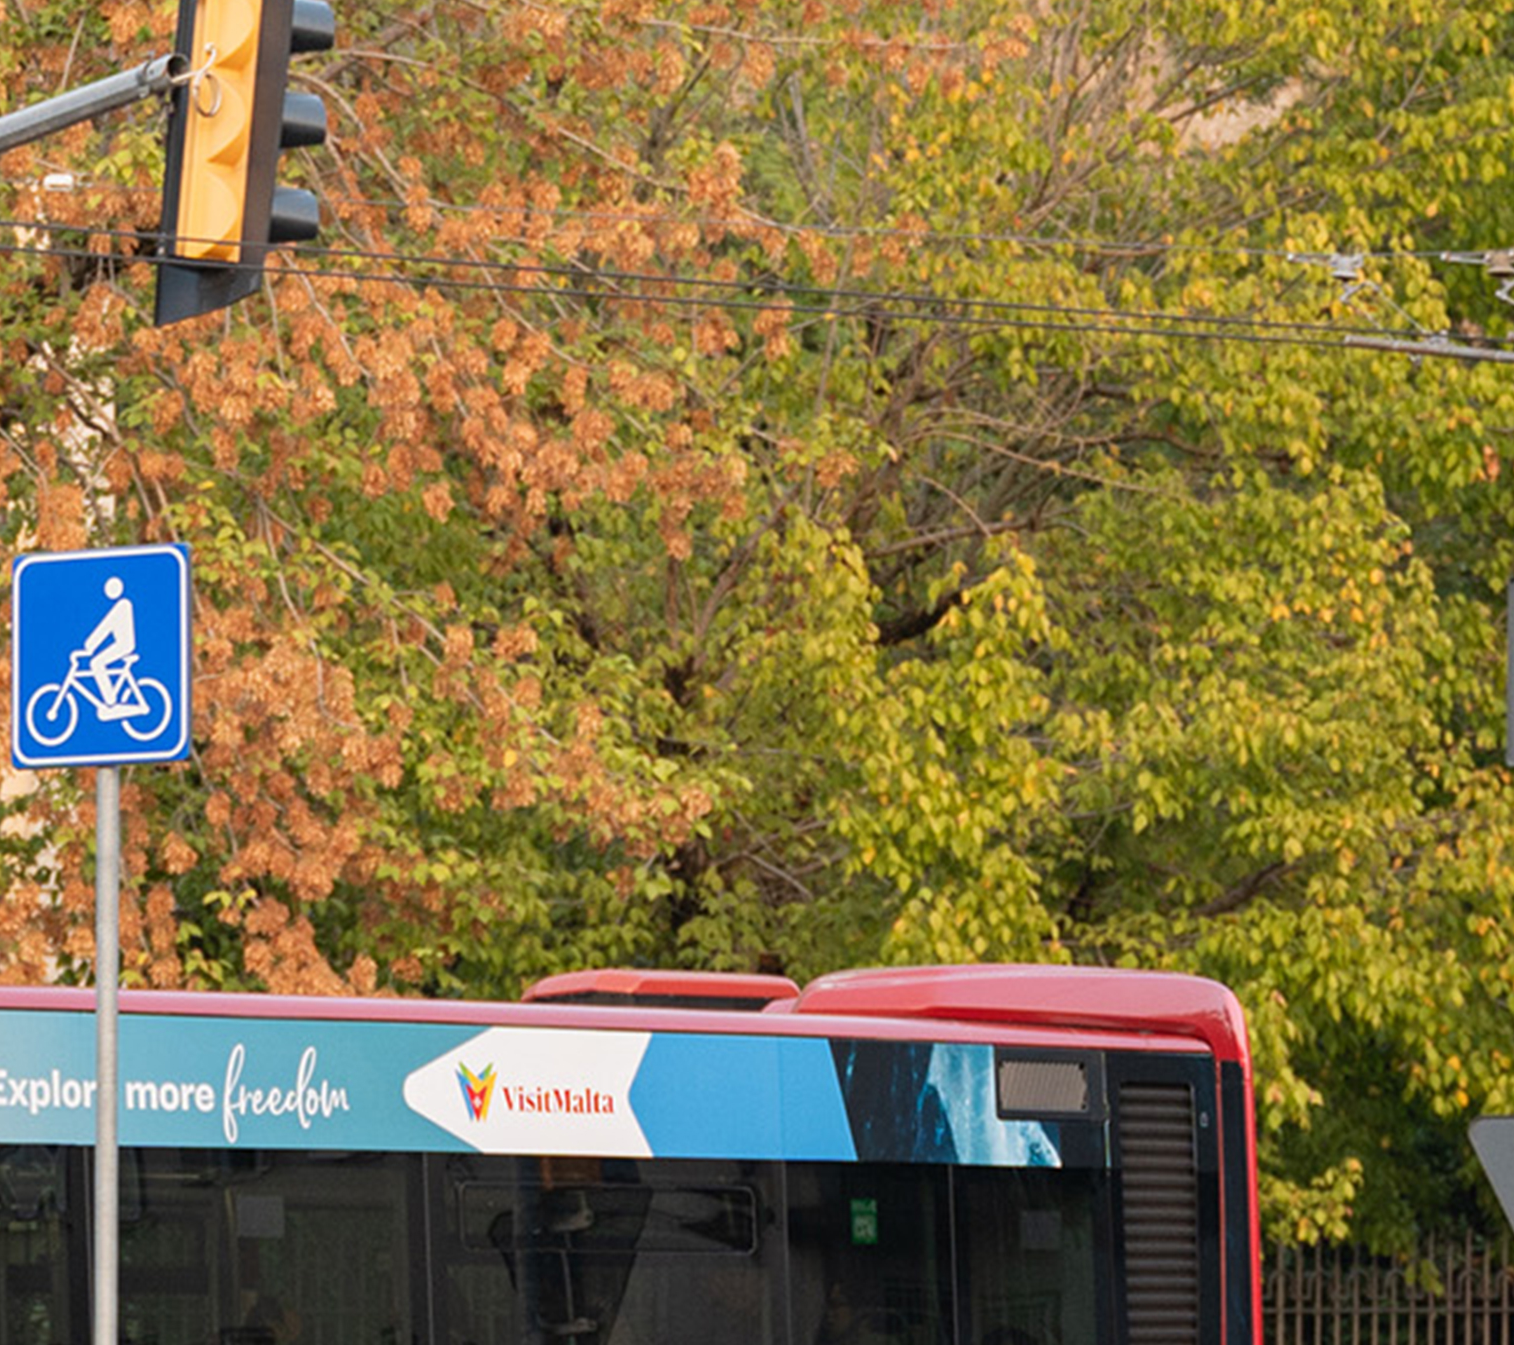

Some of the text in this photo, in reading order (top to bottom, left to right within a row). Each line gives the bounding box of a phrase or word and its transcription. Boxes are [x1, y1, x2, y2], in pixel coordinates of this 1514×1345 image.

[126, 1082, 215, 1111] more
[223, 1043, 349, 1143] freedom
[502, 1086, 614, 1114] VisitMalta
